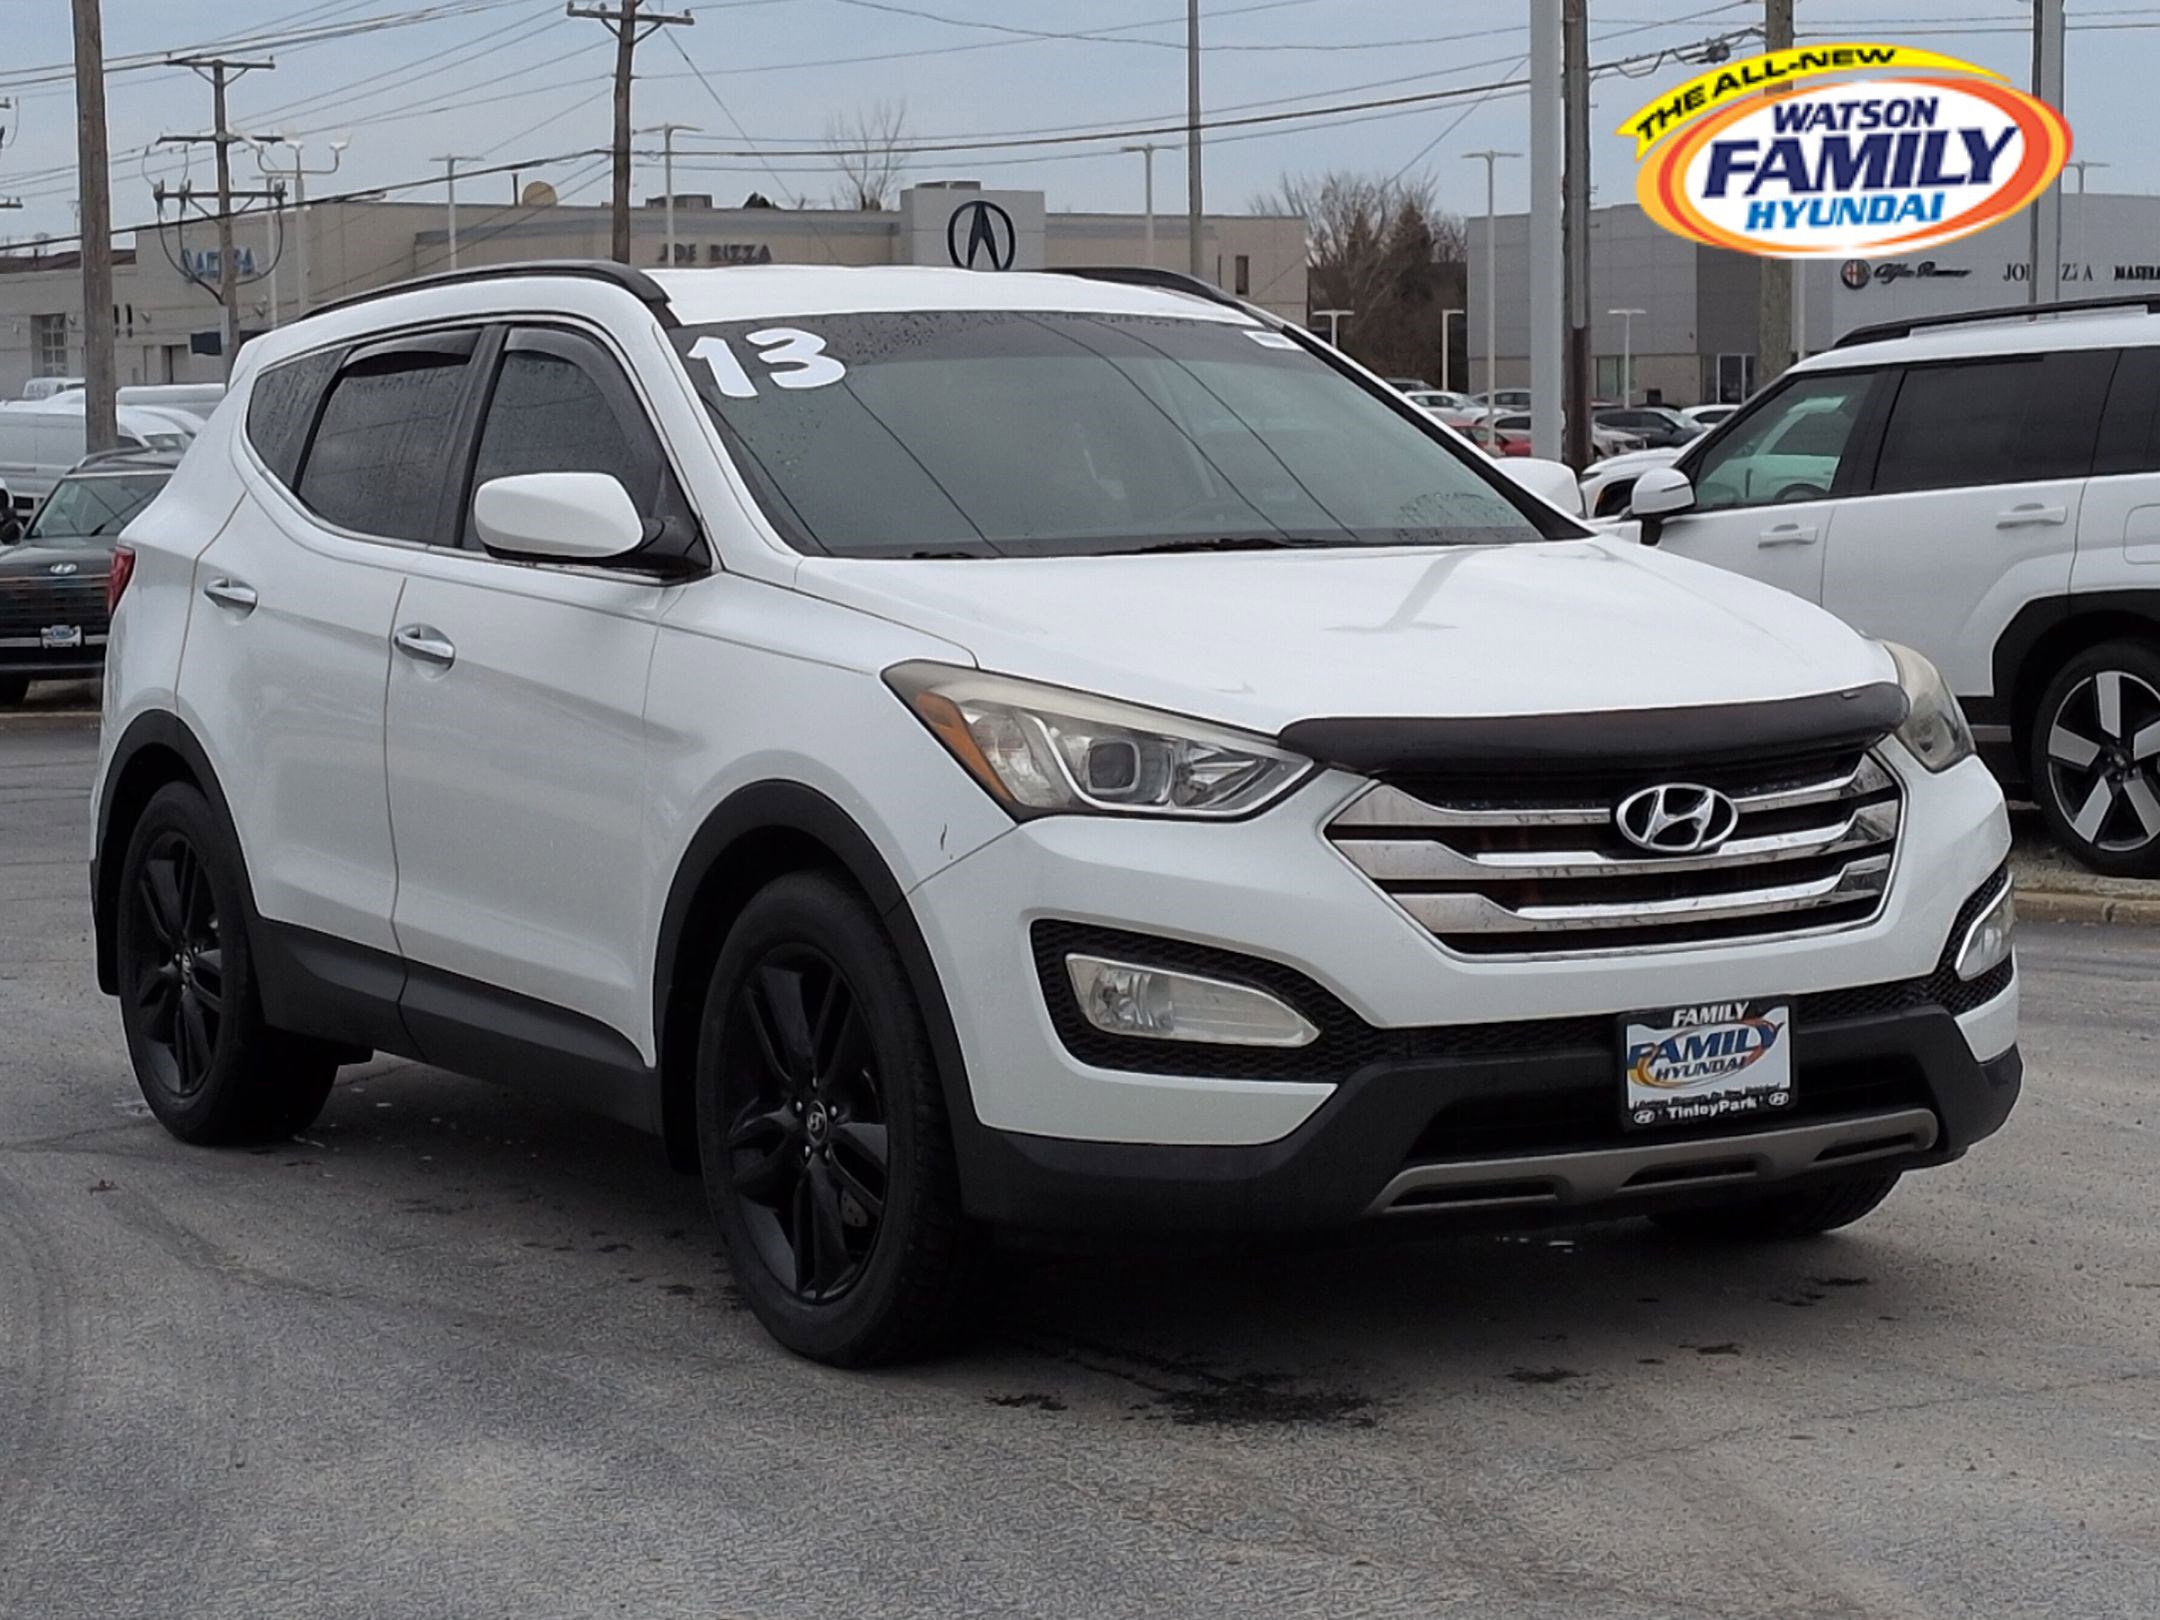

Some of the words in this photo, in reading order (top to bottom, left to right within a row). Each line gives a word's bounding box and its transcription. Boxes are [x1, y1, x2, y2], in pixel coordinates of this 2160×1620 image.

[687, 327, 847, 398] 13
[1672, 1001, 1750, 1027] FAMILY
[1627, 1022, 1784, 1068] FAMILY
[1656, 1056, 1747, 1081] HYUNDAI
